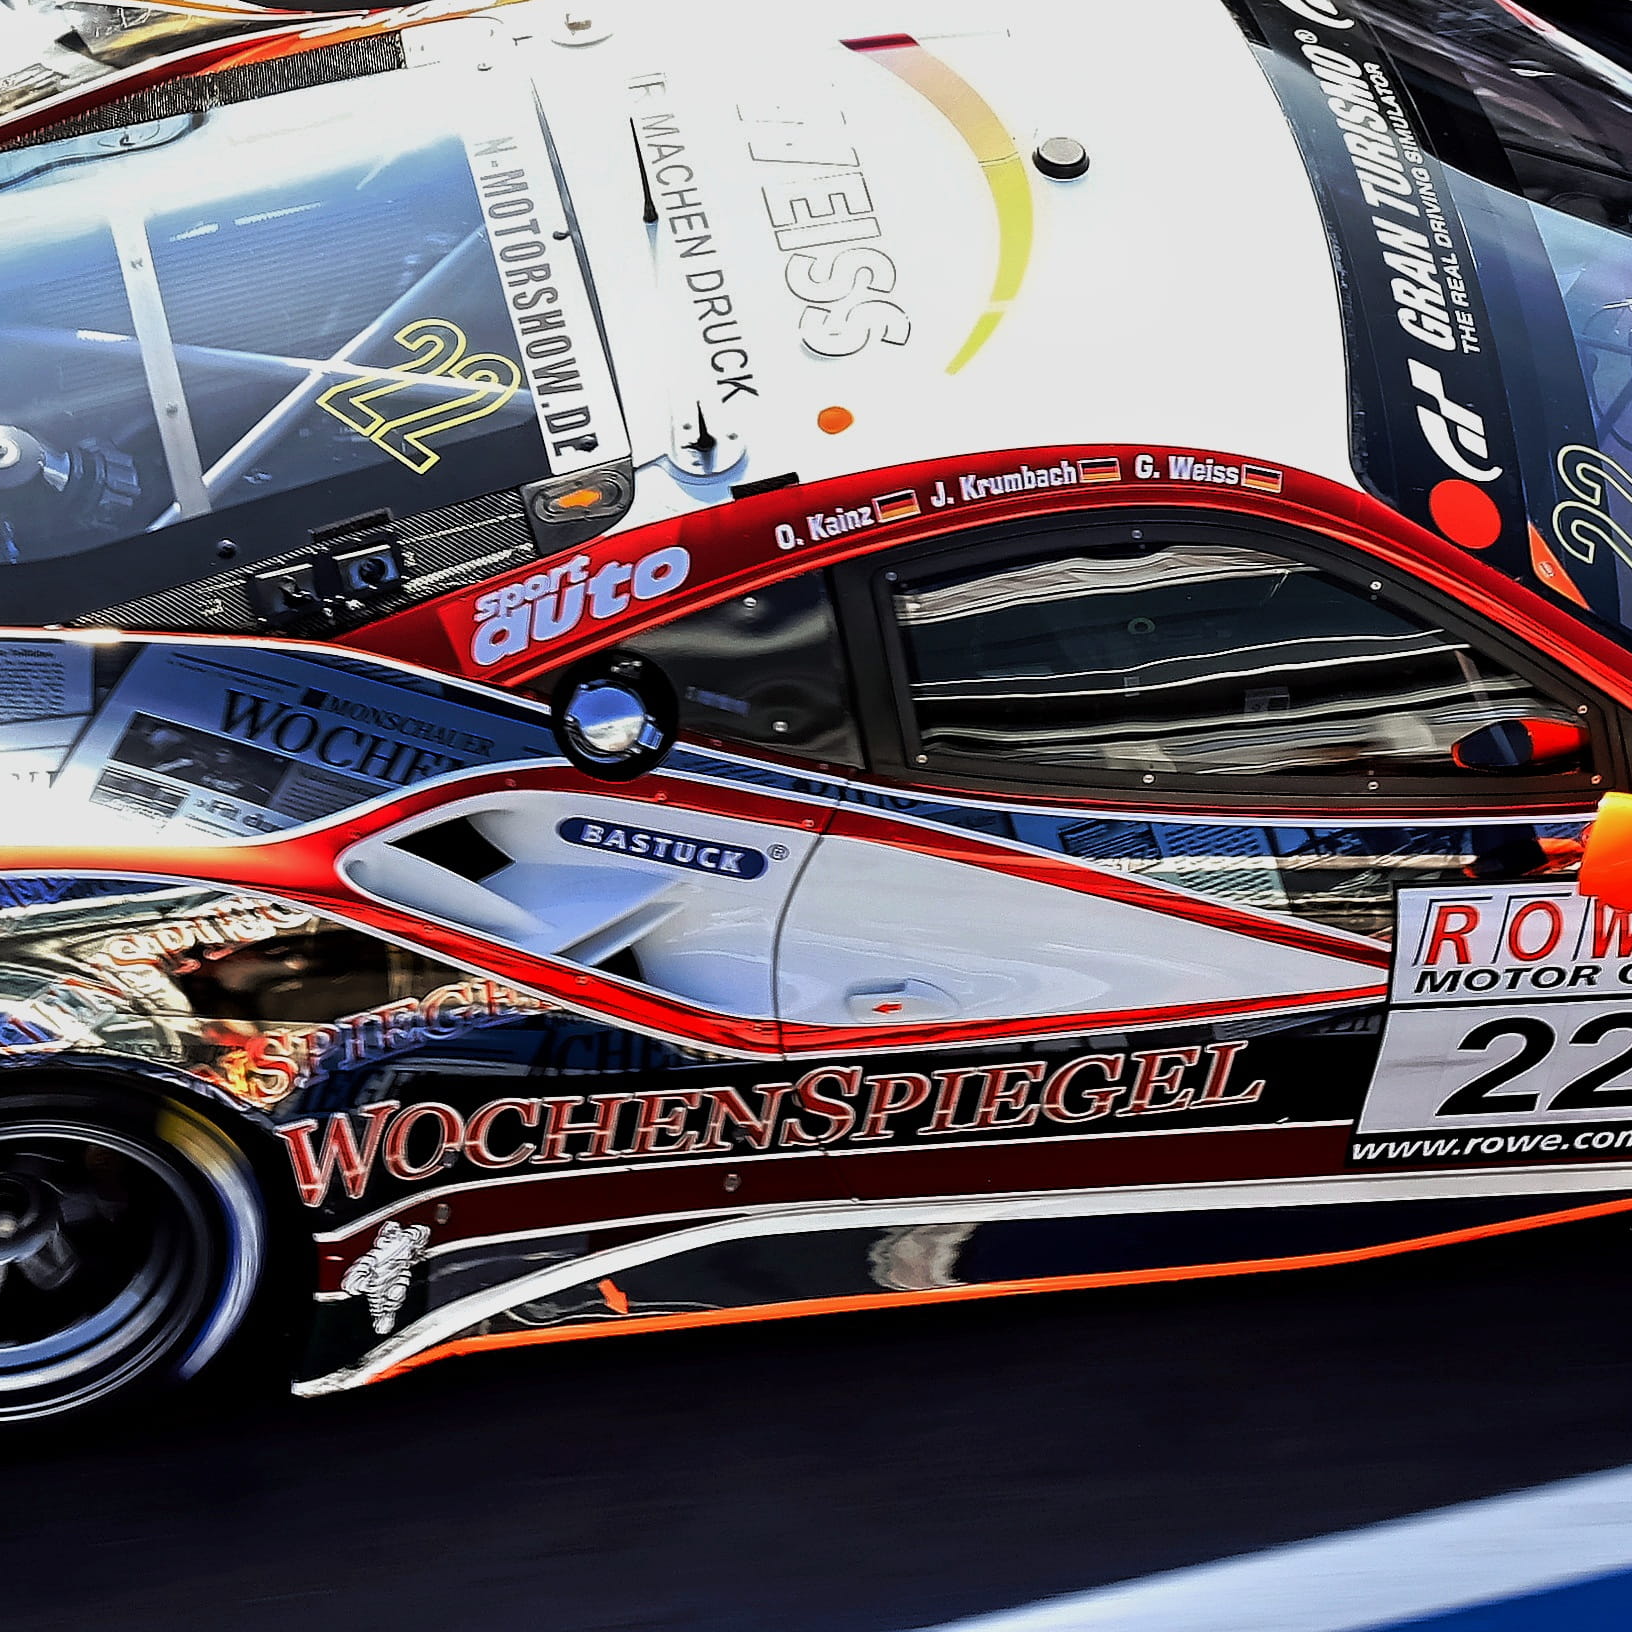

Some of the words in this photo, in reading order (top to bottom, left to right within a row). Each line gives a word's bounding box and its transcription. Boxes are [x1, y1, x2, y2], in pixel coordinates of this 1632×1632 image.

[1301, 43, 1421, 217] TURISMO
[1363, 61, 1424, 165] SIMULATOR
[1411, 167, 1453, 248] DRIVING
[640, 110, 720, 262] MACHEN
[686, 269, 760, 406] DRUCK
[1372, 216, 1457, 352] GRAN
[1443, 252, 1470, 307] REAL
[1455, 310, 1481, 355] THE
[317, 318, 520, 475] 22
[931, 483, 954, 508] J.
[959, 461, 1077, 502] Krumbach
[1134, 456, 1161, 480] G.
[1168, 457, 1239, 486] Weiss
[776, 523, 802, 552] O.
[807, 503, 874, 540] Kainz
[471, 545, 691, 670] auto
[473, 556, 593, 625] sport
[220, 688, 474, 786] WOCHE
[580, 823, 745, 873] BASTUCK
[1415, 962, 1600, 994] MOTOR
[277, 1039, 1265, 1207] WOCHENSPIEGEL
